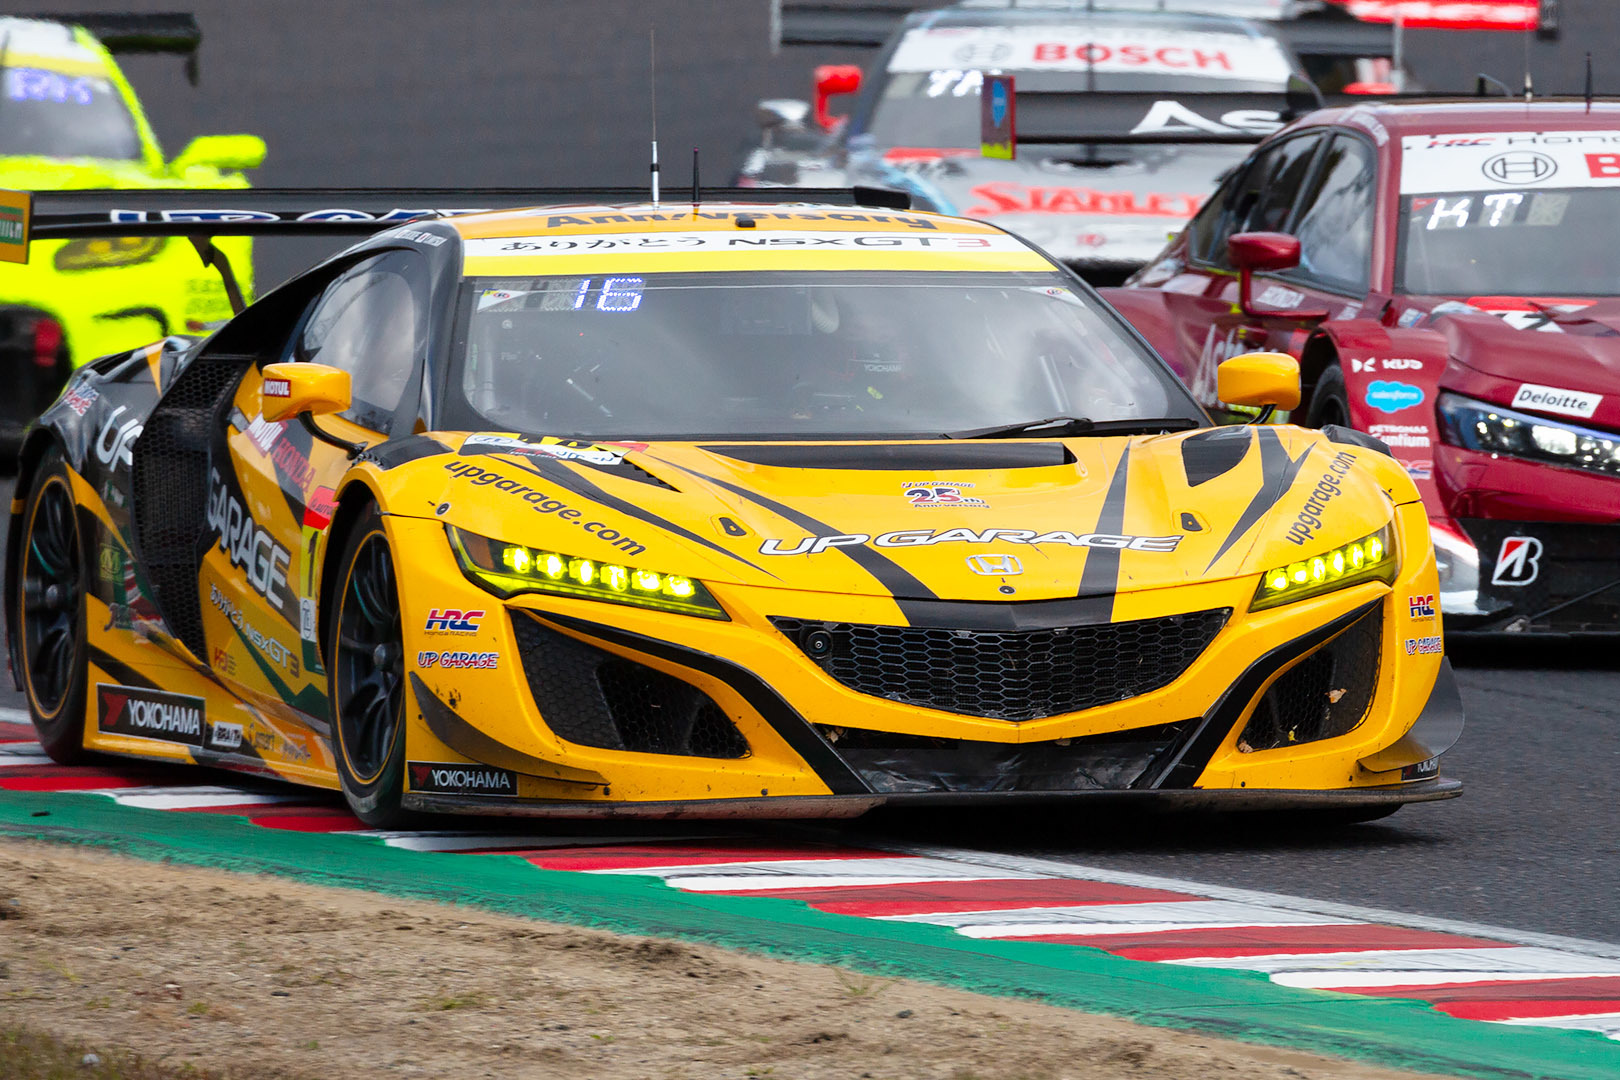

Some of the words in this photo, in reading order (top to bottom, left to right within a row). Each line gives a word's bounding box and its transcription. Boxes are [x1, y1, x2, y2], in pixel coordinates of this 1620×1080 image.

[1032, 43, 1233, 71] BOSCH
[547, 212, 938, 230] Anniversary
[500, 236, 706, 251] ありがとう
[573, 277, 644, 312] 16
[264, 379, 290, 396] MOTUL
[443, 460, 647, 557] upgarage.com
[1285, 451, 1357, 546] upgarage.com
[758, 534, 871, 556] UP
[873, 528, 1185, 553] GARAGE
[1408, 594, 1435, 618] HRC
[424, 608, 486, 632] HRC
[418, 651, 439, 668] UP
[440, 651, 500, 669] GARAGE
[128, 699, 201, 735] YOKOHAMA
[431, 769, 511, 789] YOKOHAMA
